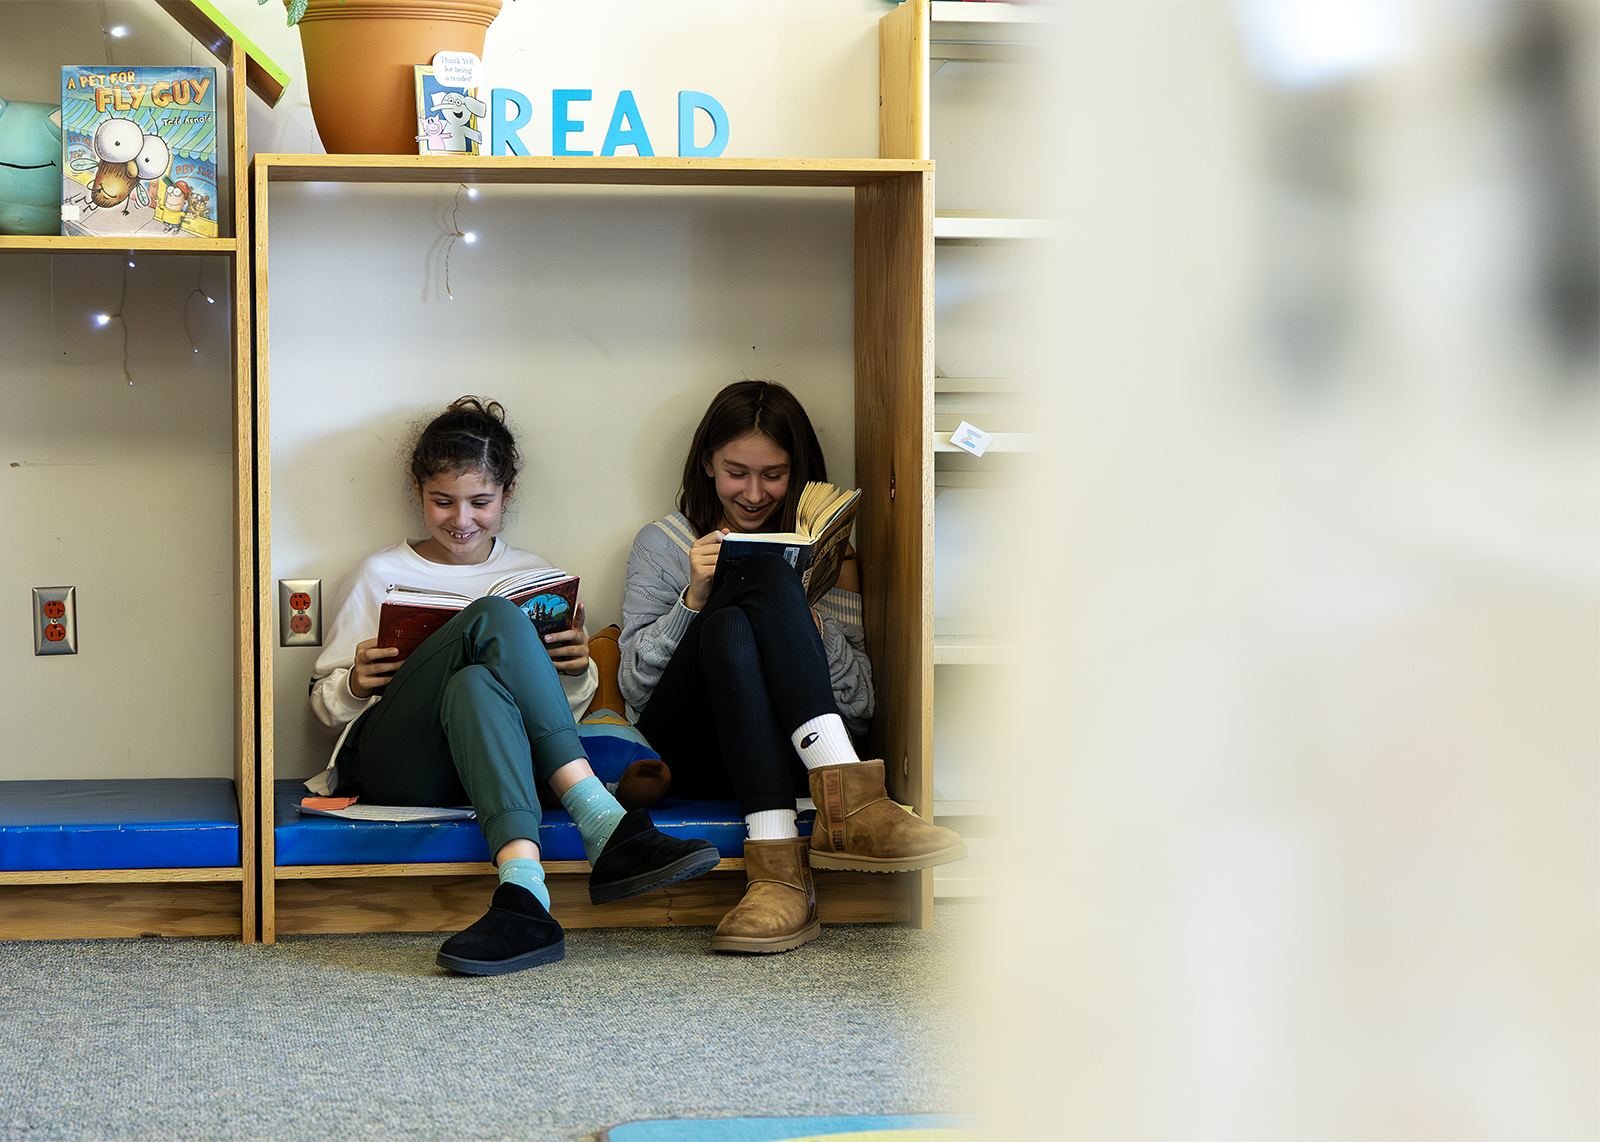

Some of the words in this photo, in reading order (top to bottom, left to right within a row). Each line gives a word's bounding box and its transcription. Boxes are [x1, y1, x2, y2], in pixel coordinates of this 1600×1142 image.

[440, 56, 460, 64] Thank
[454, 66, 472, 75] being
[67, 77, 76, 90] A
[79, 73, 106, 88] PET
[109, 70, 136, 84] FOR
[95, 83, 148, 113] FLY
[151, 78, 211, 108] GUY
[162, 117, 182, 127] Tedd
[184, 114, 212, 125] Arnold
[491, 88, 730, 158] READ
[175, 164, 196, 175] PET
